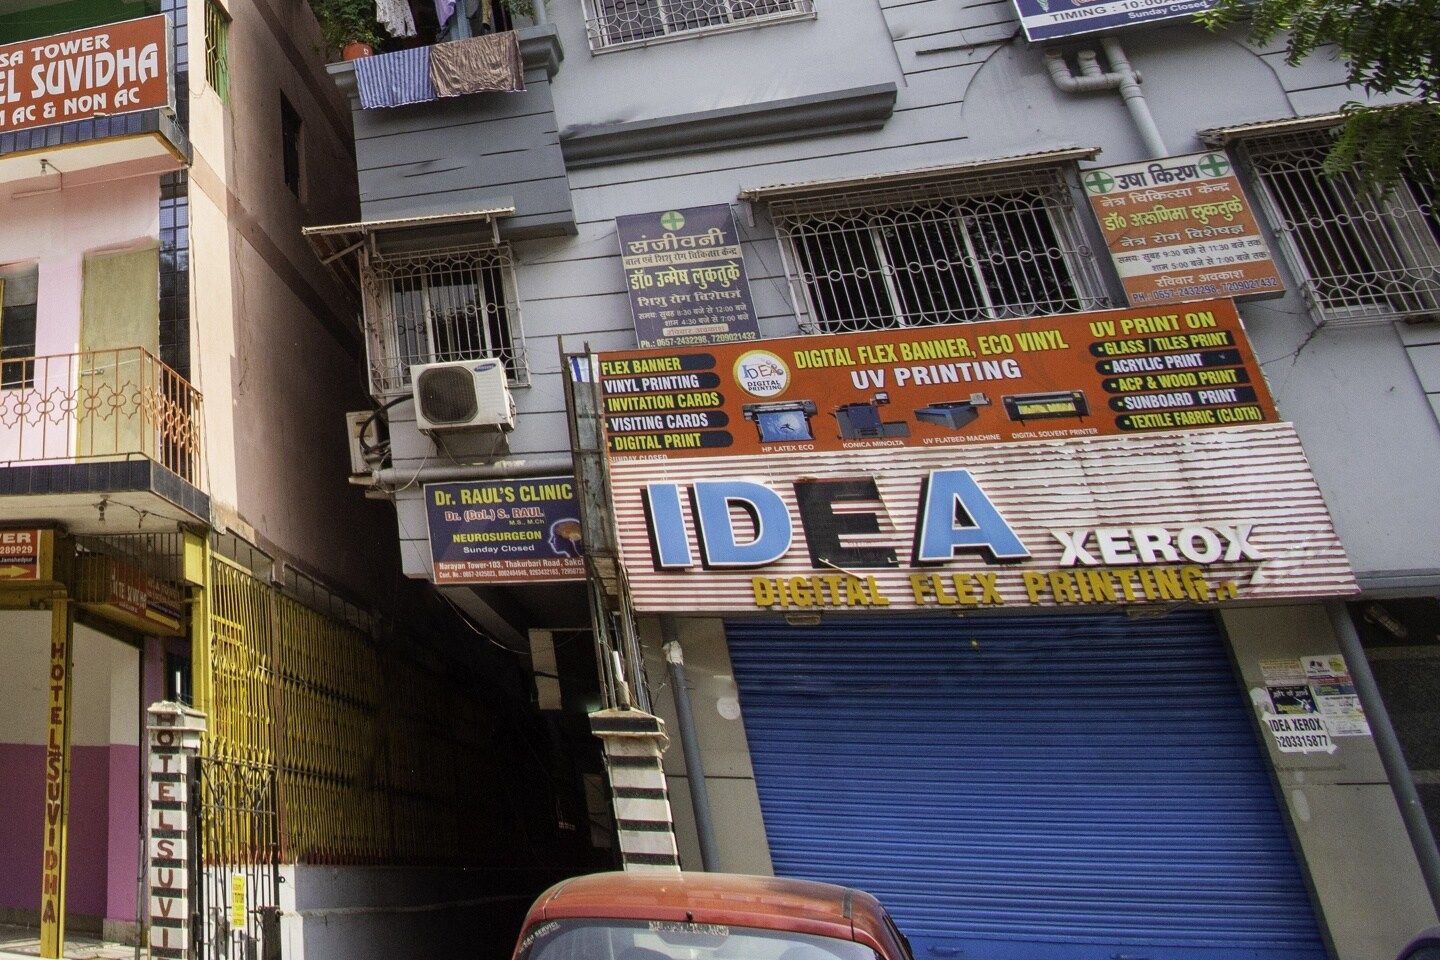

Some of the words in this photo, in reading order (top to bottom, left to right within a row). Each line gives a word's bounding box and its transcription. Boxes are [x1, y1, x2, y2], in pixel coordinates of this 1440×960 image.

[1128, 8, 1167, 19] Sunday
[1170, 0, 1207, 12] Closed
[31, 34, 110, 61] TOWER
[31, 43, 159, 99] SUVIDHA
[12, 105, 36, 125] AC
[43, 102, 56, 118] &
[64, 93, 106, 116] NON
[114, 87, 140, 108] AC
[1115, 171, 1148, 190] उषा
[1148, 164, 1199, 184] किरण
[628, 228, 726, 254] संजीवनी
[1089, 321, 1115, 338] UV
[1121, 314, 1179, 335] PRINT
[1186, 311, 1216, 328] ON
[794, 347, 856, 370] DIGITAL
[859, 344, 900, 366] FLEX
[903, 338, 976, 362] BANNER,
[979, 334, 1014, 357] ECO
[1016, 330, 1070, 352] VINYL
[601, 360, 631, 375] FLEX
[633, 357, 681, 373] BANNER
[1112, 357, 1163, 374] ACRYLIC
[1166, 354, 1203, 369] PRINT
[604, 378, 640, 394] VINYL
[642, 375, 699, 391] PRINTING
[850, 368, 886, 391] UV
[895, 359, 1022, 387] PRINTING
[608, 395, 674, 412] INVITATION
[677, 392, 720, 408] CARDS
[1124, 393, 1193, 410] SUNBOARD
[1199, 389, 1238, 405] PRINT
[611, 417, 663, 432] VISITING
[666, 413, 708, 429] CARDS
[1130, 414, 1174, 429] TEXTILE
[1175, 410, 1215, 425] FABRIC
[1217, 406, 1262, 424] (CLOTH)
[615, 436, 662, 451] DIGITAL
[665, 433, 701, 448] PRINT
[843, 441, 871, 449] KONICA
[434, 490, 456, 506] Dr.
[461, 486, 515, 505] RAUL'S
[520, 484, 573, 501] CLINIC
[641, 468, 1031, 573] IDEA
[1051, 523, 1262, 568] XEROX
[452, 531, 542, 543] NEUROSURGEON
[463, 546, 498, 554] Sunday
[752, 574, 893, 610] DIGITAL
[911, 571, 1009, 606] FLEX
[1269, 719, 1292, 732] IDEA
[1291, 718, 1323, 731] XEROX
